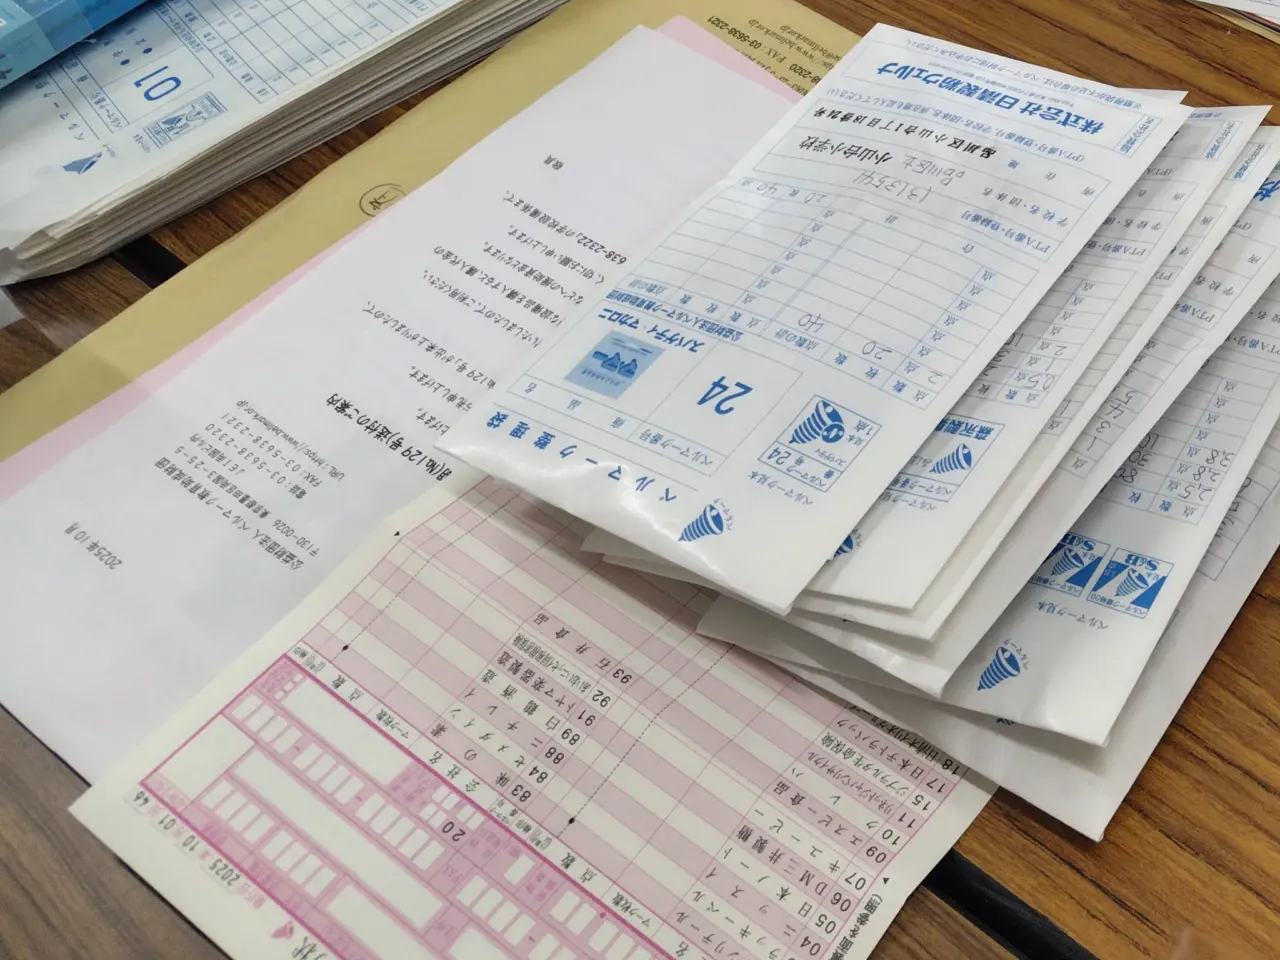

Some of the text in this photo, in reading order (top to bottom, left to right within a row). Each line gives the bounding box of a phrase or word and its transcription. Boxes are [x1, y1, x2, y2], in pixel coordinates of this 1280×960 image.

[132, 66, 182, 102] 01
[876, 58, 1019, 109] 日清製粉ウェルナ
[812, 104, 996, 159] 品川区小山台1丁目18番24号
[1018, 99, 1104, 135] 株式会社
[798, 133, 893, 167] 小山台小学校
[1006, 158, 1095, 196] 所在地
[981, 186, 1070, 228] 学校名・団体名
[960, 209, 1051, 252] PTA番号・登録番号
[479, 239, 584, 305] などへの援助資金となります。
[504, 222, 606, 285] く、切にお願い申し上げます。
[431, 242, 565, 328] な設備品を購入すると、購入代金の
[678, 291, 718, 316] 枚数
[419, 268, 542, 349] いたしましたので、ご利用ください。
[605, 287, 743, 341] 公益財団法人ベルマーク教育助成財団
[728, 308, 760, 330] 点数
[773, 325, 819, 353] 点数の計
[796, 309, 942, 385] 2 20 40
[832, 351, 880, 380] 枚数
[695, 369, 753, 423] 24
[891, 378, 929, 404] 点数
[1002, 381, 1039, 410] 点数
[523, 379, 714, 466] ベルマーク番号 商品名
[844, 431, 864, 447] 見本
[854, 419, 875, 436] 1点
[481, 406, 682, 505] ベルマーク整理袋
[766, 443, 827, 487] ベルマーク 24
[793, 454, 836, 479] 番号
[746, 468, 814, 506] ベルマーク見本
[1127, 489, 1198, 524] 点数 枚
[153, 454, 304, 572] 公益財団法人 ベルマーク教育助成財団
[63, 520, 123, 571] 2025年10月
[1060, 527, 1097, 556] S&B
[1123, 547, 1160, 575] S&B
[1033, 598, 1109, 632] ベルマーク見本
[532, 611, 633, 686] 93 石井食品
[479, 667, 582, 747] 89 白鶴酒造
[495, 648, 597, 728] 91 トヤマ楽器製造
[590, 688, 612, 709] 92
[327, 672, 480, 794] 会社名 マーク枚数 点数
[445, 704, 550, 785] 84 セメダイン
[461, 685, 566, 766] 88 ニチレイ
[429, 719, 533, 803] 83 味の素
[819, 730, 933, 812] 15 ジブラルタ生命保険
[834, 714, 947, 794] 17 日本テトラパック
[939, 756, 962, 777] 18
[156, 811, 177, 832] 01
[439, 818, 468, 844] 20
[772, 779, 889, 864] 09 エスビー食品
[879, 826, 903, 847] 10
[896, 809, 918, 829] 11
[180, 832, 201, 853] 10
[205, 856, 242, 889] 2025
[556, 850, 652, 927] マーク枚数 点数
[735, 822, 853, 912] 06 DM三井製糖
[842, 868, 868, 892] 07
[703, 864, 823, 957] 04 ニッスイ
[720, 844, 839, 934] 05 日本ノート
[688, 885, 781, 960] ラッキーベル
